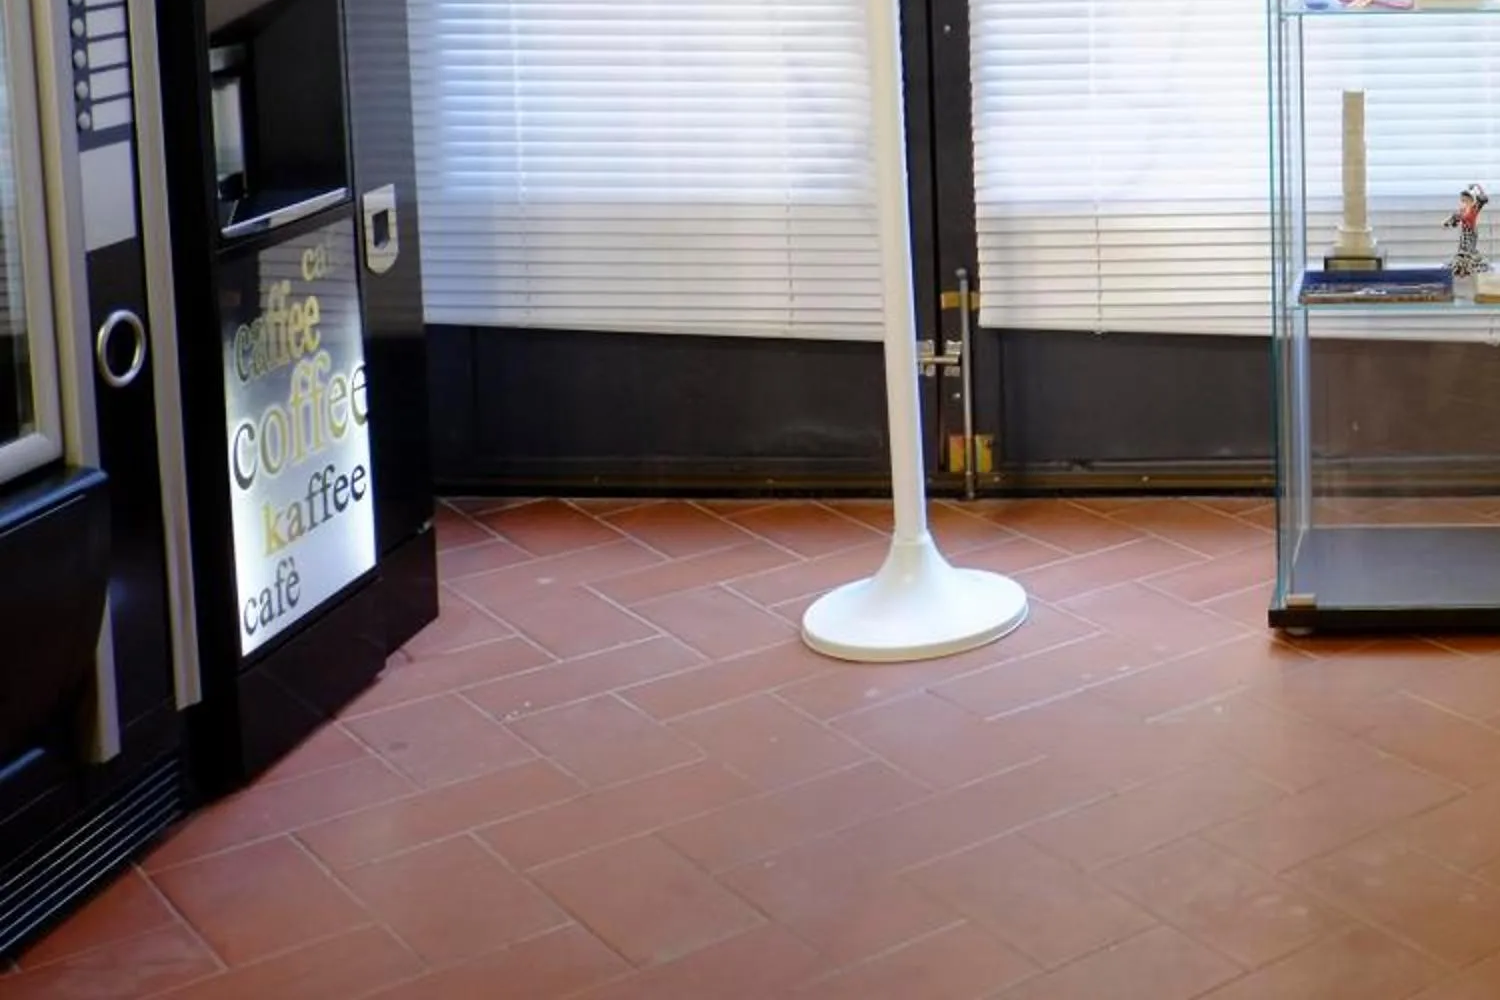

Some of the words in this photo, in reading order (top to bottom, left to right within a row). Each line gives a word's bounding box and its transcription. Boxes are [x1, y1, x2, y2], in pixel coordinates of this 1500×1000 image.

[234, 279, 320, 384] caffee
[232, 350, 368, 491] coffee
[262, 463, 367, 556] kaffee
[242, 556, 301, 637] cafè
